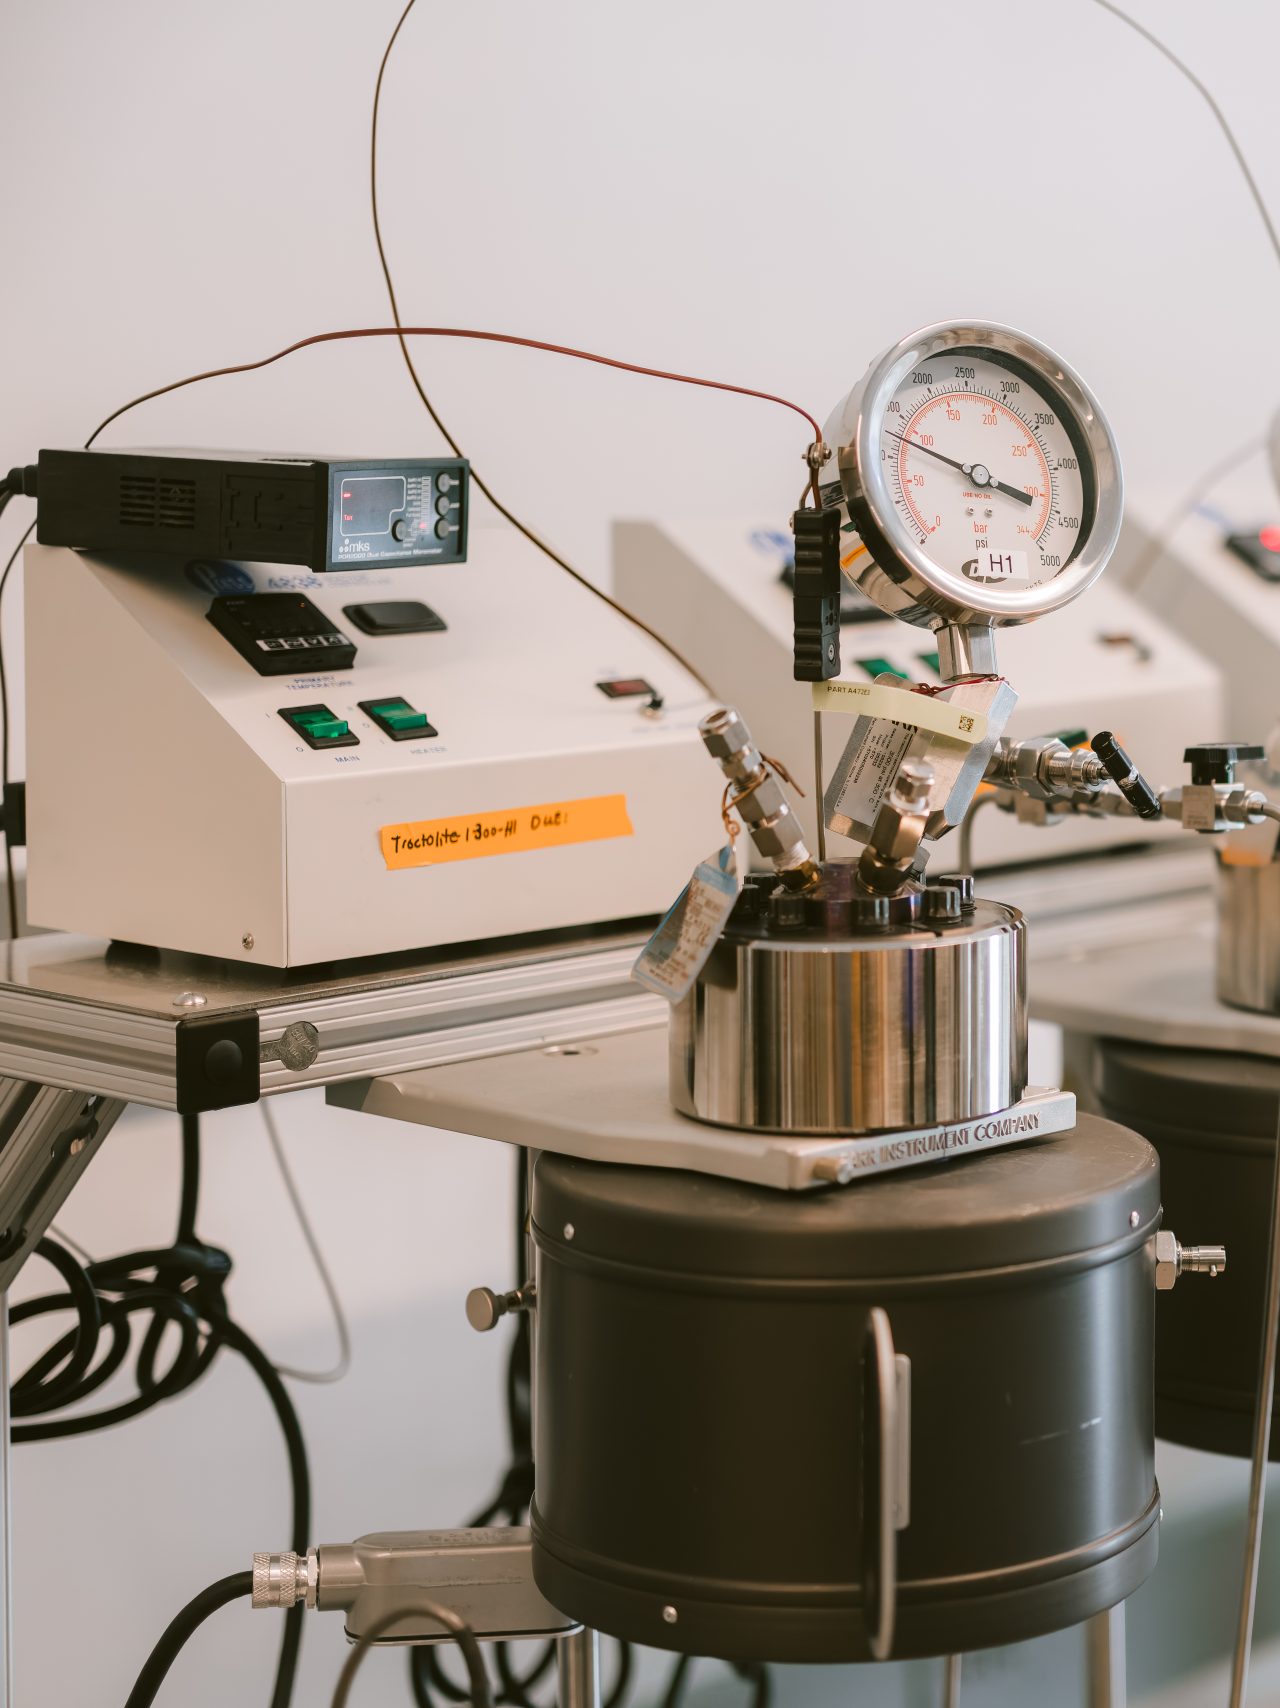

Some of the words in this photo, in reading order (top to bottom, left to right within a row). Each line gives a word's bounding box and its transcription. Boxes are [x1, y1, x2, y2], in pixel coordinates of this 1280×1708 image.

[912, 372, 933, 385] 2000
[955, 367, 975, 379] 2500
[1000, 381, 1020, 394] 3000
[946, 409, 961, 421] 150
[982, 414, 998, 426] 200
[1035, 413, 1054, 425] 3500
[919, 434, 934, 446] 100
[1012, 445, 1027, 457] 250
[1057, 457, 1077, 470] 4000
[913, 475, 925, 487] 50
[1023, 486, 1039, 498] 300
[935, 515, 941, 527] 0
[1058, 517, 1079, 529] 4500
[973, 522, 988, 534] bar
[1016, 526, 1030, 534] 344
[349, 541, 370, 552] mks
[975, 537, 988, 551] psi
[989, 553, 1013, 574] H1
[1040, 555, 1061, 567] 5000
[827, 686, 846, 694] PART
[880, 1127, 971, 1162] INSTRUMENT
[974, 1112, 1041, 1141] COMPANY
